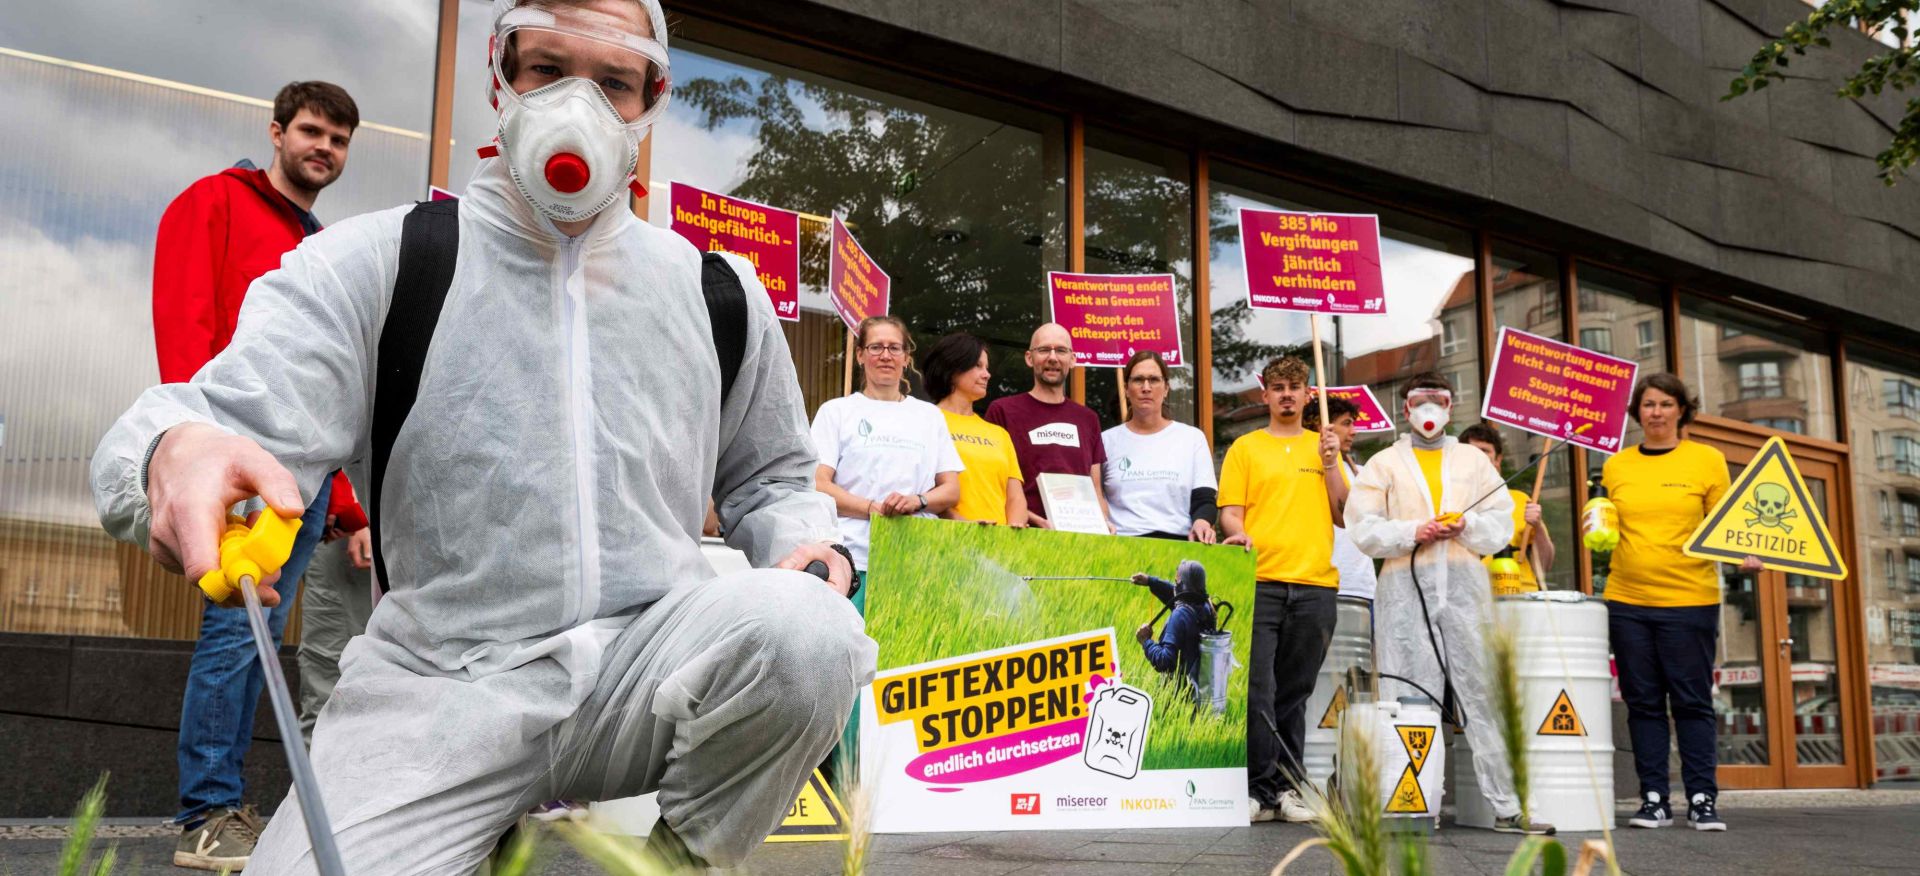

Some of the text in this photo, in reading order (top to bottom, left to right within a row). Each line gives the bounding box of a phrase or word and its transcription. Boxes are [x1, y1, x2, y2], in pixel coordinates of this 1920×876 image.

[701, 193, 767, 225] In Europa
[676, 204, 780, 246] hochgefährlich
[1279, 215, 1338, 233] 385 Mio
[1260, 231, 1359, 254] Vergiftungen
[1282, 253, 1342, 273] jährlich
[1055, 278, 1169, 294] Verantwortung endet
[1272, 273, 1357, 292] verhindern
[1065, 293, 1093, 306] nicht
[1095, 297, 1109, 306] an
[1084, 313, 1144, 327] Stoppt den
[1071, 327, 1128, 341] Giftexport
[1507, 334, 1631, 379] Verantwortung endet
[1513, 353, 1544, 369] nicht
[1545, 362, 1560, 375] an
[1508, 386, 1570, 413] Giftexport
[1528, 376, 1593, 404] Stoppt den
[952, 433, 993, 446] NKOTA
[1726, 529, 1808, 556] PESTIZIDE
[881, 639, 1106, 715] GIFTEXPORTE
[922, 683, 1081, 748] STOPPEN!
[923, 732, 1081, 778] endlich durchsetzen
[1056, 794, 1108, 806] misereor
[1121, 798, 1168, 810] INKOTA
